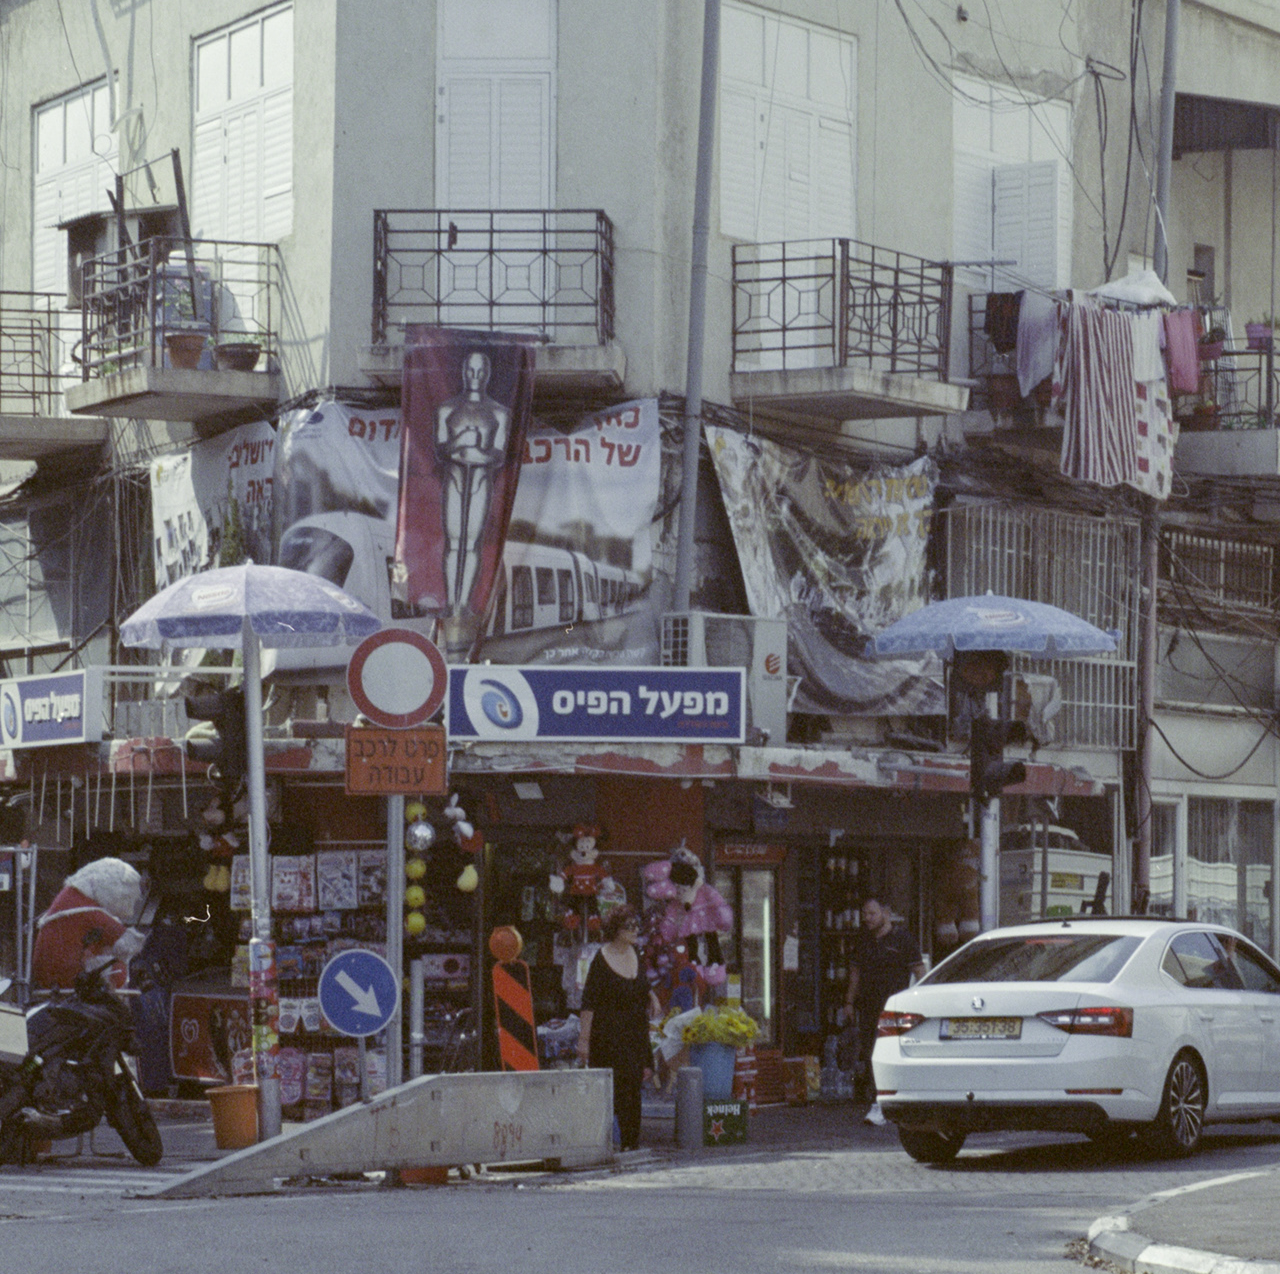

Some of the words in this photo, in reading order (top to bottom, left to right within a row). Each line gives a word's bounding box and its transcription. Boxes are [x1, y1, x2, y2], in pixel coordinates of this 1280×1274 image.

[348, 417, 401, 442] דום
[600, 436, 642, 467] של
[24, 697, 51, 722] הפיס
[50, 691, 81, 722] מפעל
[552, 690, 632, 716] הפיס
[639, 685, 729, 719] מפעל
[353, 735, 397, 758] לרכב
[405, 739, 440, 758] פרט
[368, 764, 425, 786] עבודה
